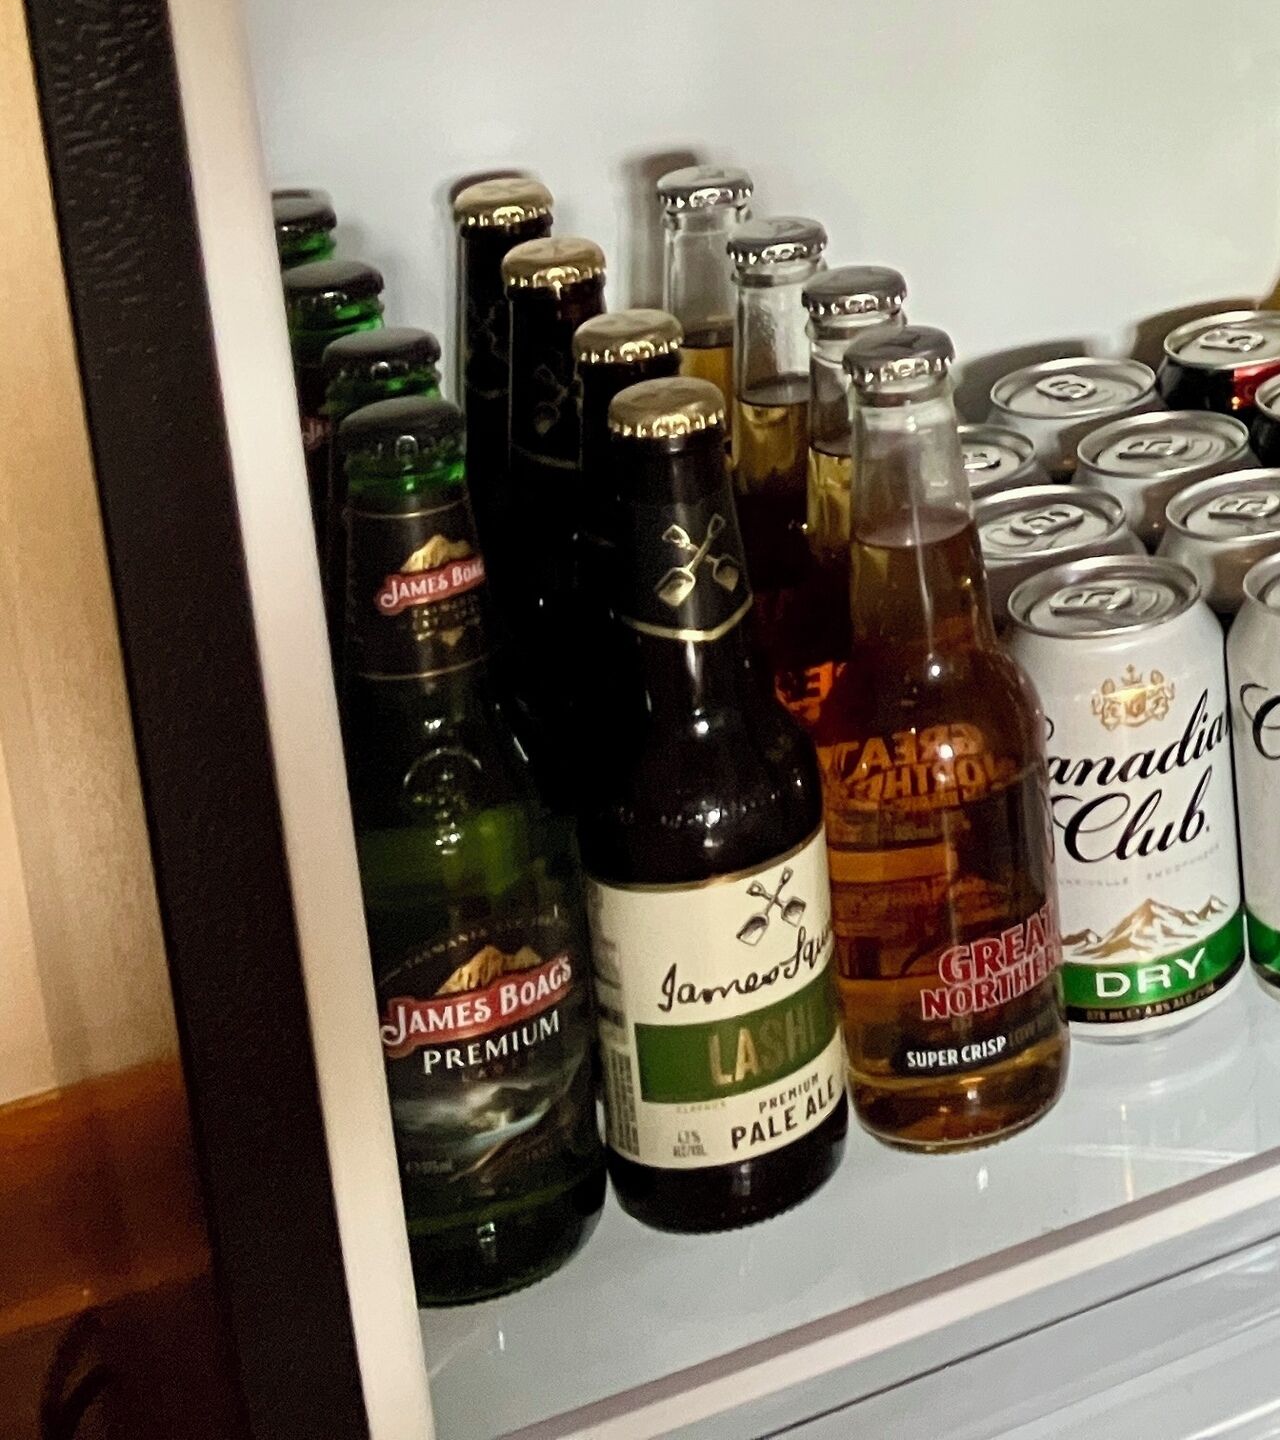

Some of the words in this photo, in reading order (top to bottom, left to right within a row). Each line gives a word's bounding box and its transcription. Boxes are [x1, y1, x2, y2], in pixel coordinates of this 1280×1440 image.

[380, 574, 449, 608] JAMES
[656, 962, 780, 1014] James
[1095, 946, 1206, 998] DRY
[380, 997, 492, 1046] JAMES
[422, 1009, 560, 1076] PREMIUM
[906, 1048, 959, 1069] SUPER
[961, 1035, 1007, 1063] CRISP
[730, 1105, 800, 1151] PALE
[804, 1073, 836, 1123] ALE
[757, 1071, 820, 1115] PREMIUM
